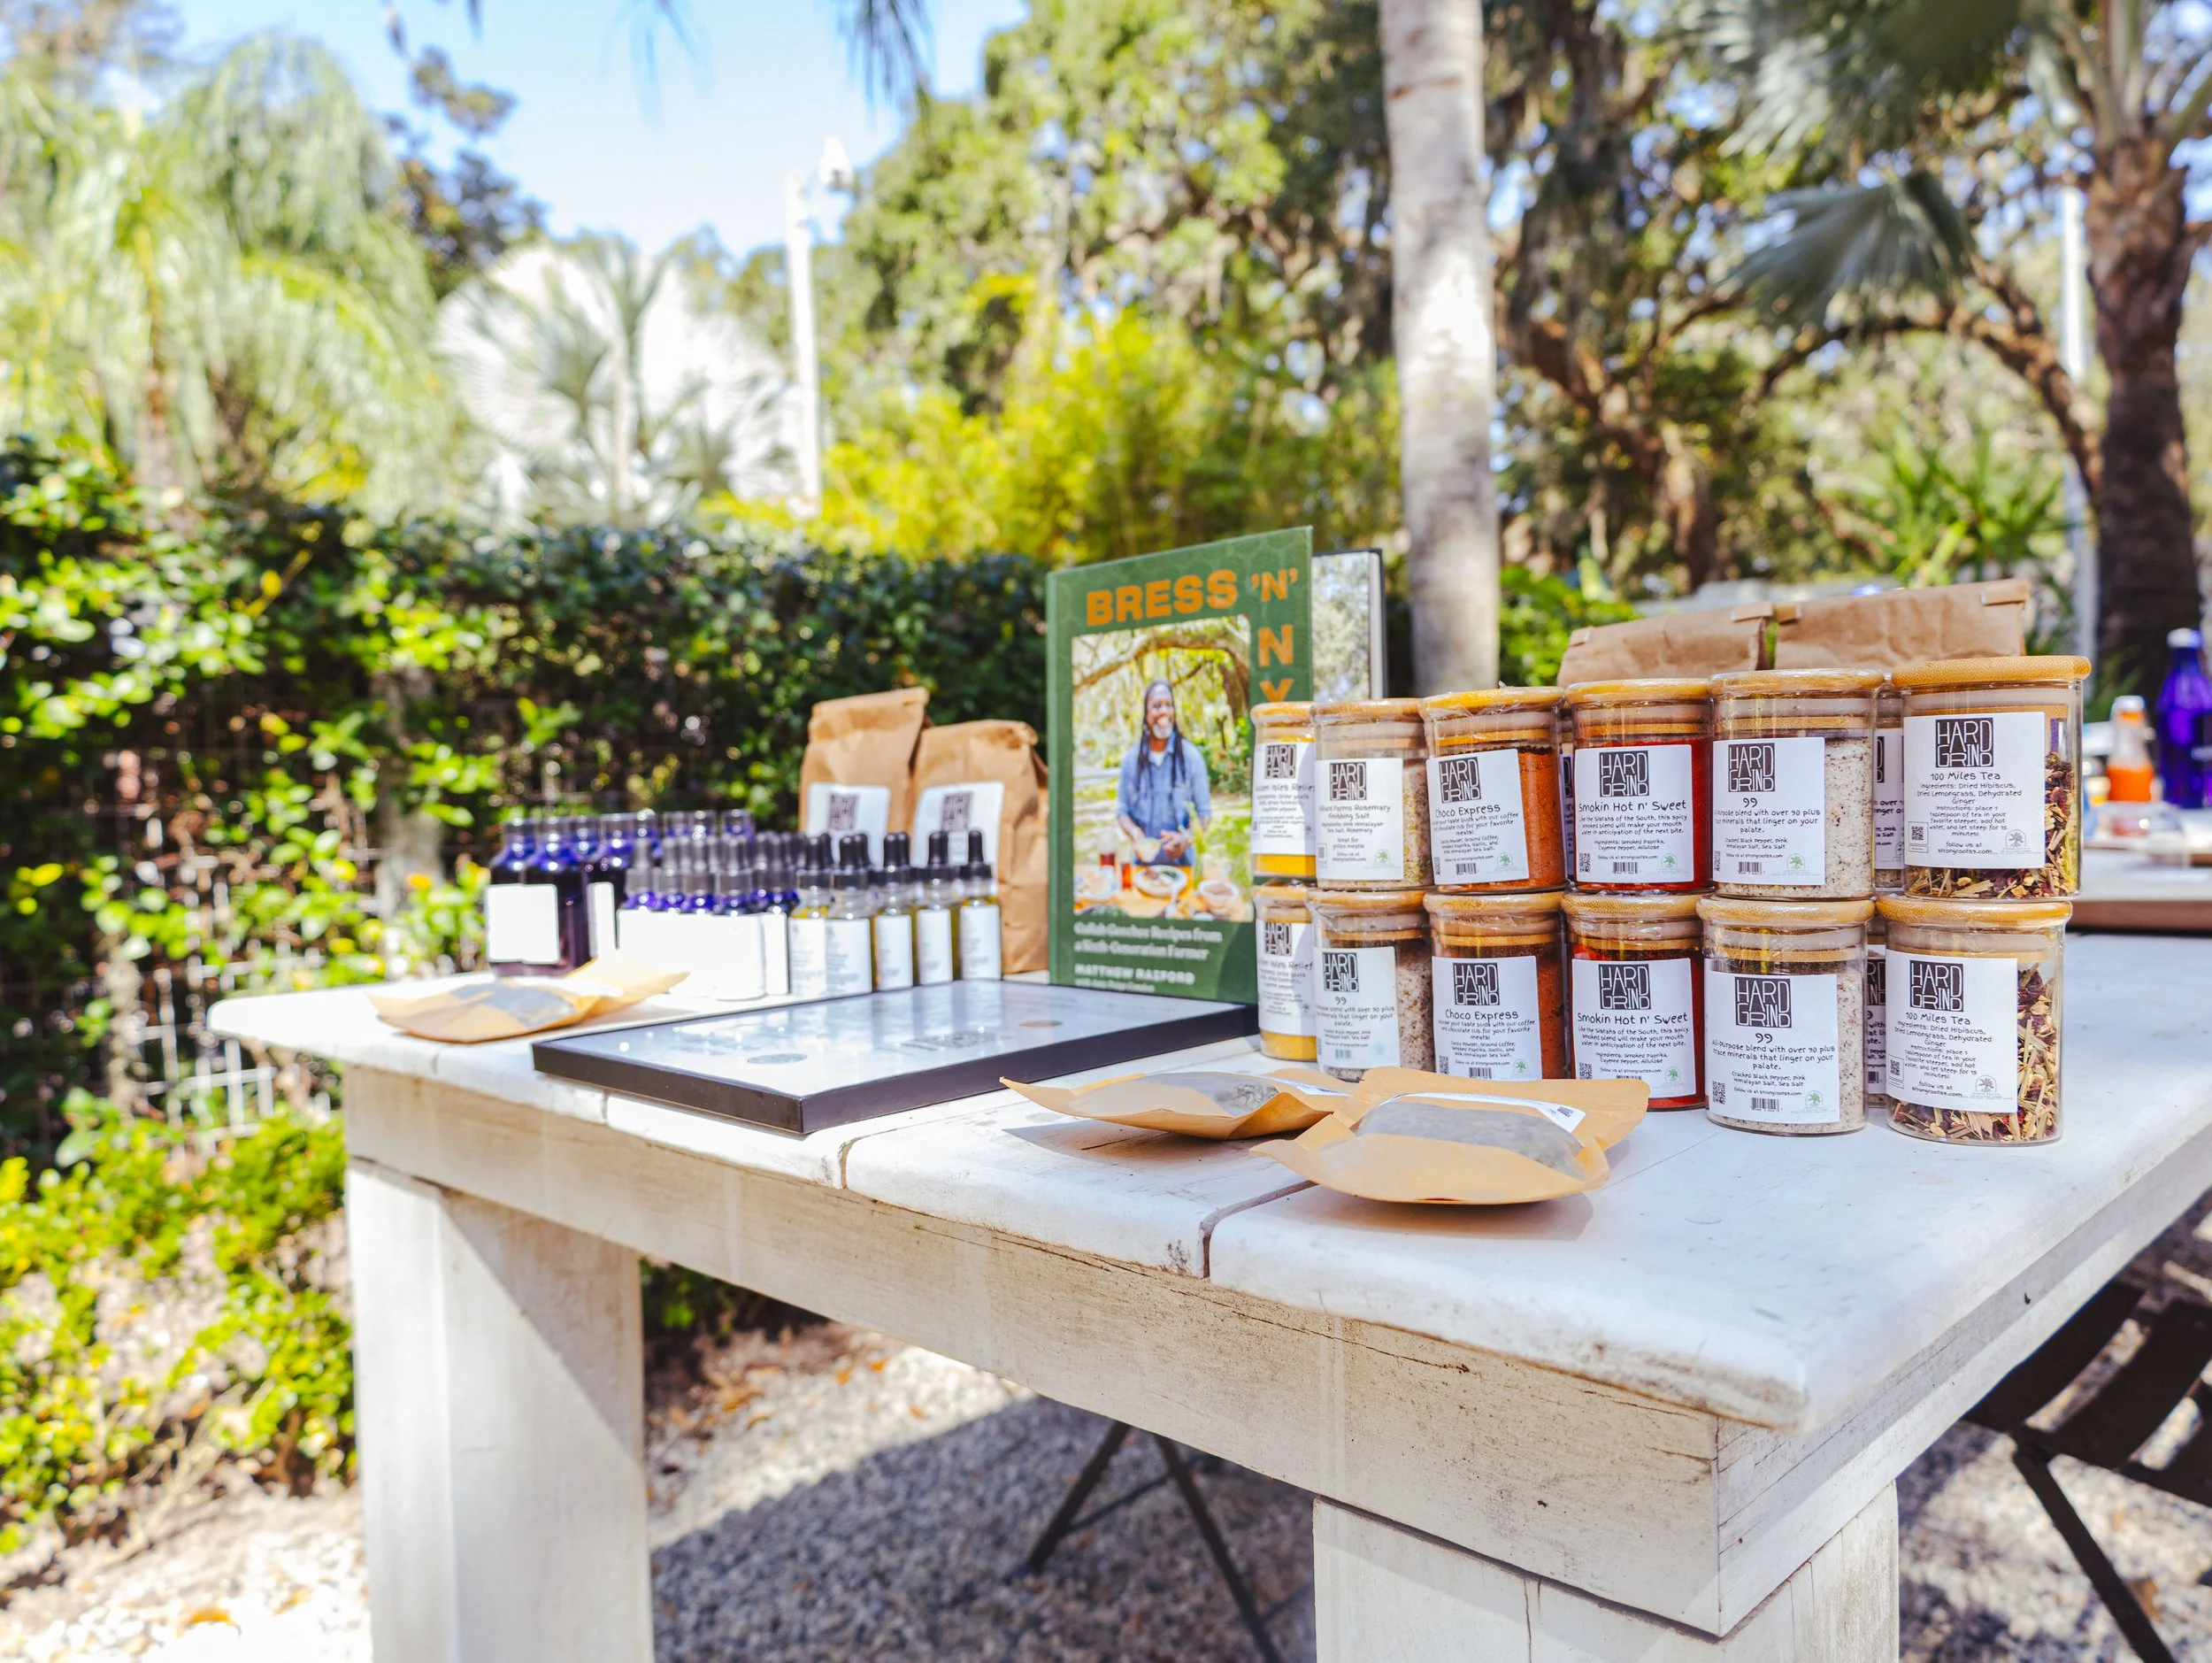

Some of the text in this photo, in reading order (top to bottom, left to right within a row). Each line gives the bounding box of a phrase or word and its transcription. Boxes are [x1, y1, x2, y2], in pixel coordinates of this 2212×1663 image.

[1087, 569, 1239, 627] BRESS
[1938, 720, 1992, 752] HARD
[1730, 746, 1773, 777] HARD
[1938, 744, 1993, 767] GRIND
[1331, 764, 1366, 789] HARD
[1439, 759, 1479, 788] HARD
[1601, 753, 1647, 783] HARD
[1331, 781, 1366, 800] GRIND
[1601, 774, 1648, 797] GRIND
[1730, 769, 1774, 791] GRIND
[1440, 781, 1480, 803] GRIND
[1743, 797, 1758, 807] 99
[1435, 804, 1501, 818] Choco Express
[1579, 802, 1609, 812] Smokin
[1613, 802, 1633, 812] Hot
[1653, 800, 1686, 811] Sweet
[1324, 953, 1356, 979] HARD
[1324, 972, 1358, 991] GRIND
[1455, 965, 1498, 992] HARD
[1600, 966, 1648, 997] HARD
[1911, 963, 1962, 997] HARD
[1455, 985, 1499, 1005] GRIND
[1601, 988, 1649, 1009] GRIND
[1737, 980, 1789, 1012] HARD
[1911, 985, 1962, 1011] GRIND
[1446, 1010, 1518, 1022] Choco Express
[1578, 1012, 1610, 1024] Smokin
[1615, 1015, 1635, 1024] Hot
[1655, 1012, 1688, 1024] Sweet
[1738, 1003, 1790, 1028] GRIND
[1921, 1013, 1947, 1023] Miles
[1951, 1016, 1970, 1025] Tea
[1755, 1033, 1772, 1043] 99
[1907, 1030, 1947, 1040] Lemongrass,
